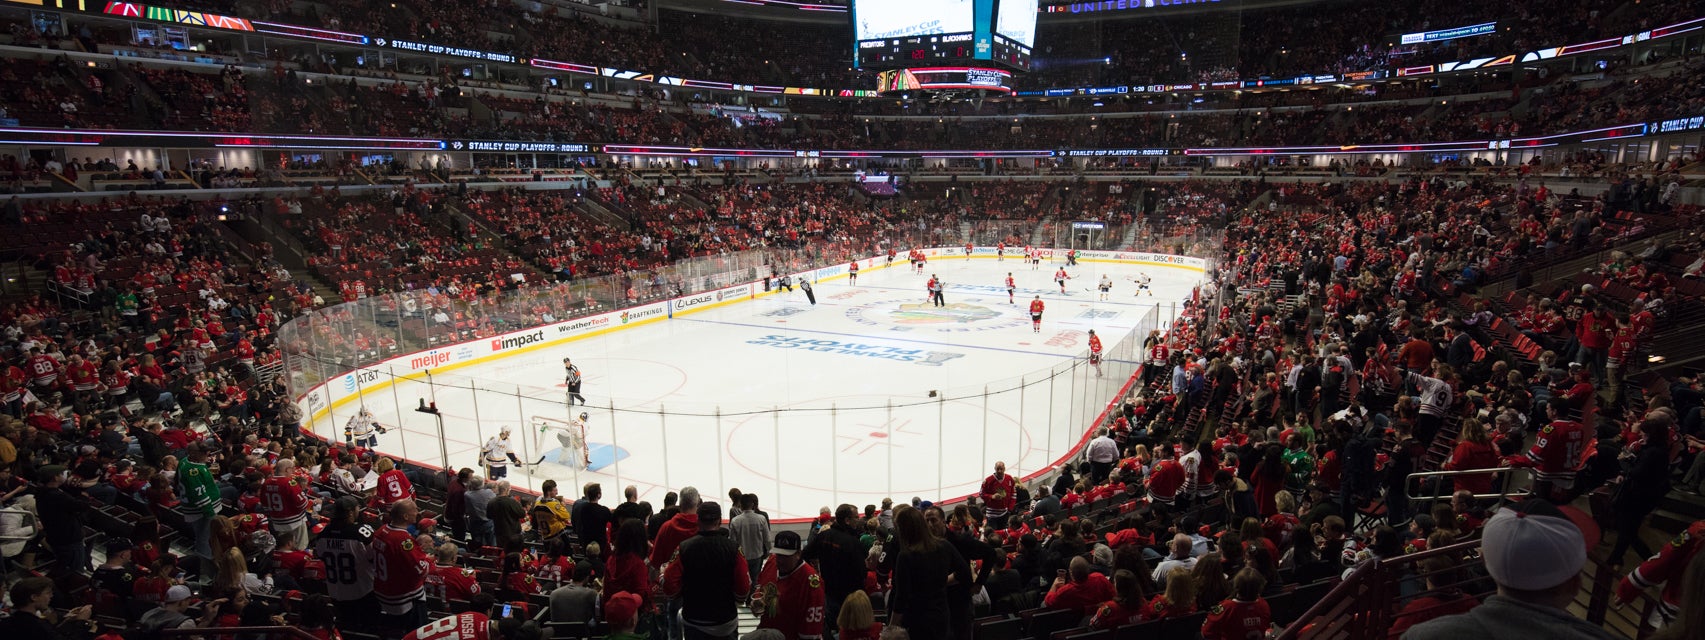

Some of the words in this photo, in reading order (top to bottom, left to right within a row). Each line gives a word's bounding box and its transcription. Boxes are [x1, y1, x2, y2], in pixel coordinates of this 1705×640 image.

[1071, 0, 1140, 13] UNITED
[920, 20, 940, 30] CUP
[392, 40, 426, 51] STANLEY
[446, 48, 480, 58] PLAYOFFS
[488, 53, 510, 62] ROUND
[1661, 118, 1689, 132] STANLEY
[1689, 116, 1703, 129] CUP
[469, 142, 503, 150] STANLEY
[1154, 255, 1184, 264] DISCOVER
[685, 295, 712, 306] LEXUS
[629, 308, 662, 320] DRAFTKINGS
[559, 317, 609, 332] WeatherTech
[501, 331, 544, 349] impact
[411, 350, 450, 369] meijer
[34, 361, 54, 374] 88
[358, 370, 378, 383] AT&T
[1536, 436, 1547, 448] 19
[388, 481, 402, 498] 9
[264, 492, 284, 512] 19
[327, 540, 344, 550] KANE
[322, 552, 357, 584] 88
[806, 606, 823, 622] 35
[460, 613, 475, 640] HOSSA
